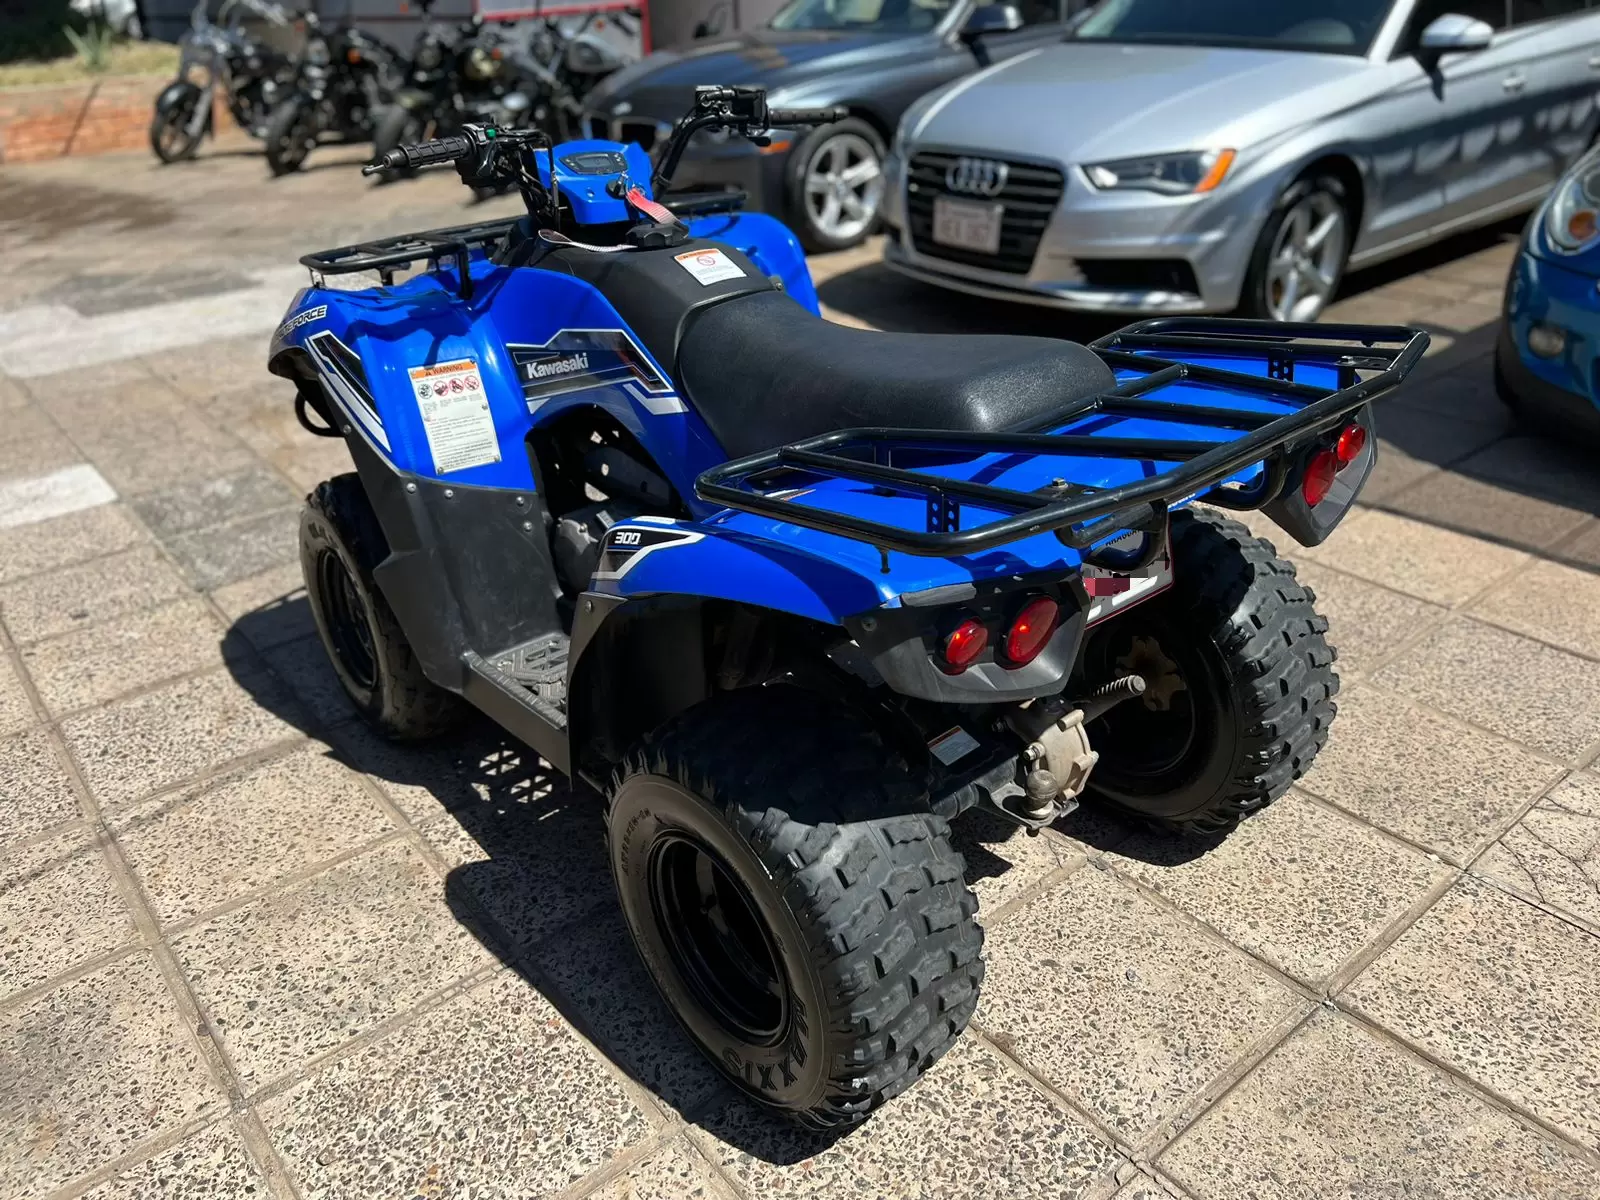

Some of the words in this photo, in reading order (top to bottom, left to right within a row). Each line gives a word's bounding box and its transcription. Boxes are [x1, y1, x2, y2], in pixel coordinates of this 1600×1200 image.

[433, 364, 464, 375] WARNING
[526, 352, 589, 379] Kawasaki
[614, 532, 641, 545] 300
[722, 984, 808, 1092] MAXXIS
